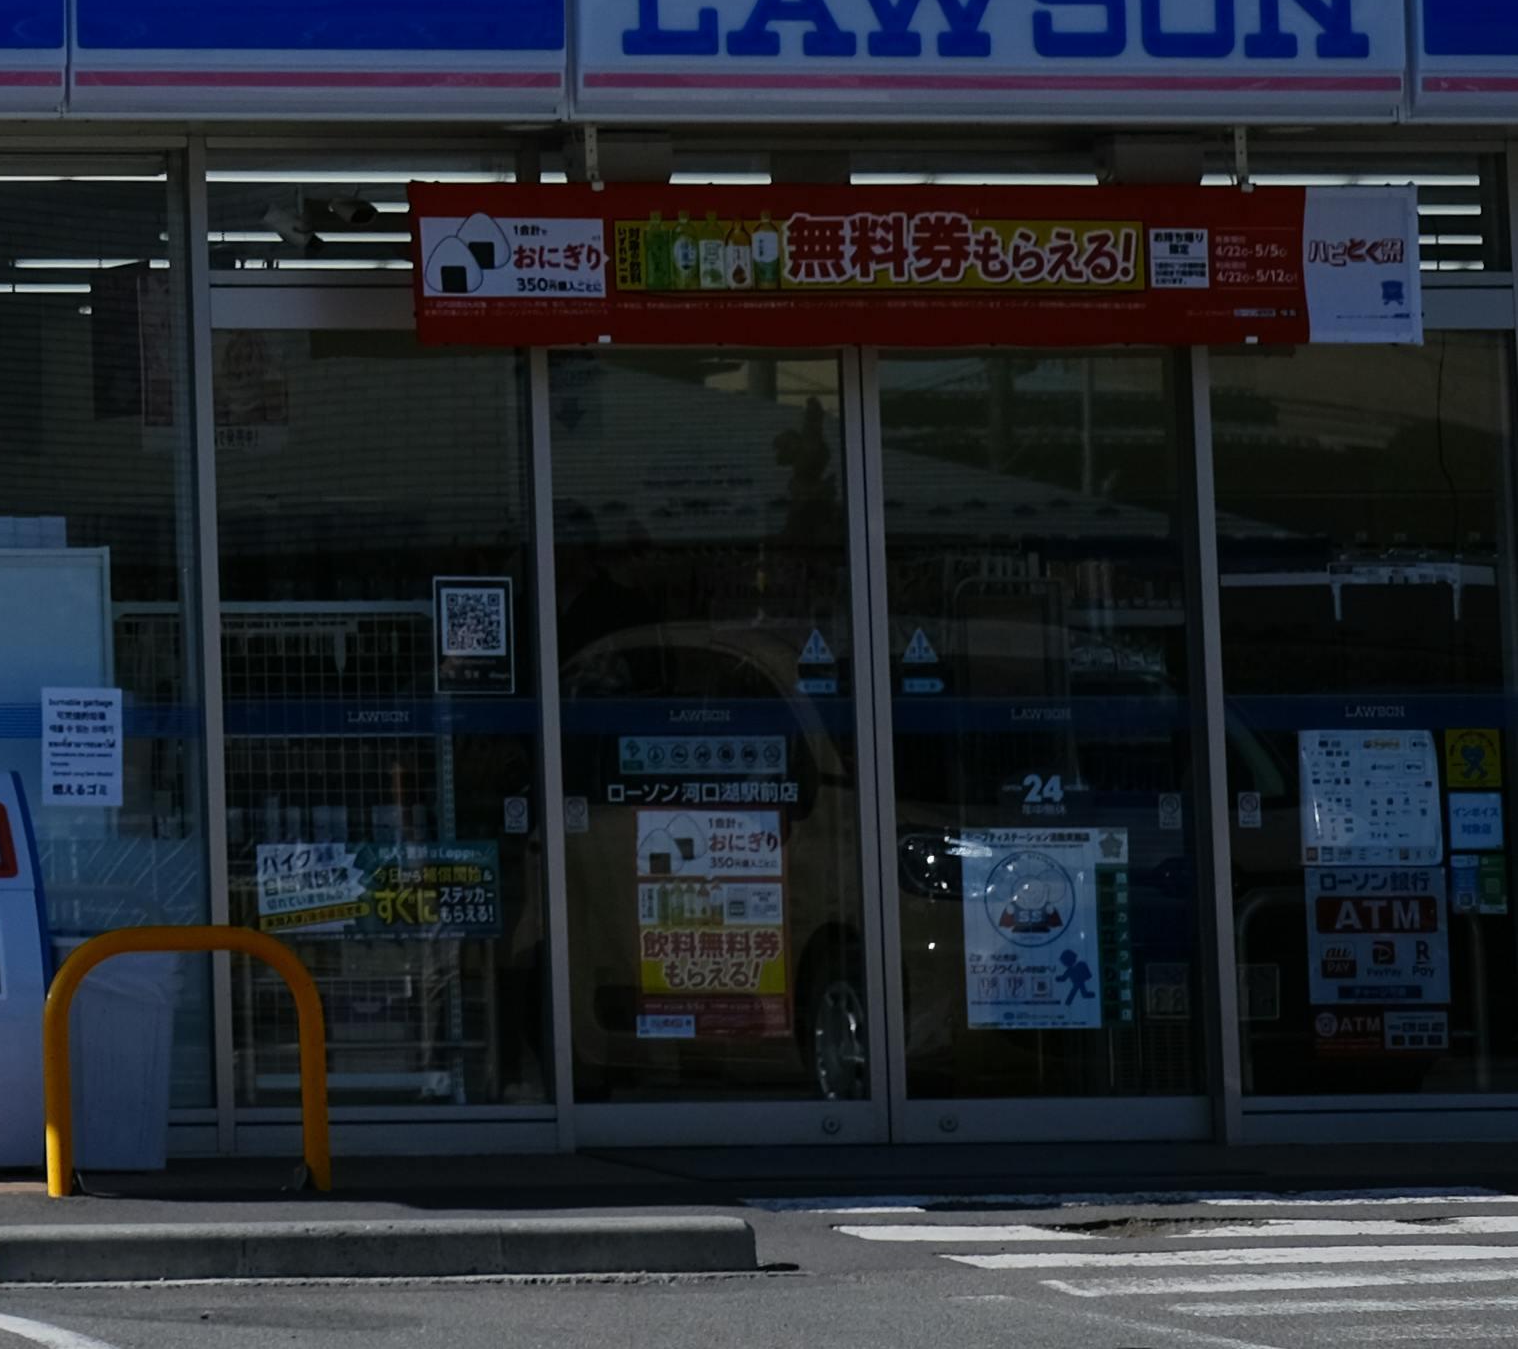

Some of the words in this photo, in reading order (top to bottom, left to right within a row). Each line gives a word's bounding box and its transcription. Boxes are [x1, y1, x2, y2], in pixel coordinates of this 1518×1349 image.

[512, 243, 601, 271] おにぎり
[346, 710, 410, 723] LAWSON
[668, 709, 732, 722] LAWSON
[1010, 707, 1072, 720] LAWSON
[1344, 704, 1408, 719] LAWSON
[1022, 773, 1065, 803] 24
[709, 831, 779, 853] おにぎり
[1319, 872, 1430, 891] ローソン銀行
[439, 886, 495, 904] ステッカー
[375, 887, 439, 924] すぐに
[439, 904, 496, 925] もらえる!
[1018, 909, 1043, 924] SS
[1335, 900, 1421, 930] ATM
[642, 931, 781, 959] 飲料無料券
[1415, 940, 1431, 961] R
[665, 960, 761, 988] もらえる!
[1327, 961, 1351, 973] PAY
[1366, 966, 1402, 977] PayPay
[1412, 965, 1435, 978] Pay
[1339, 1016, 1382, 1032] ATM
